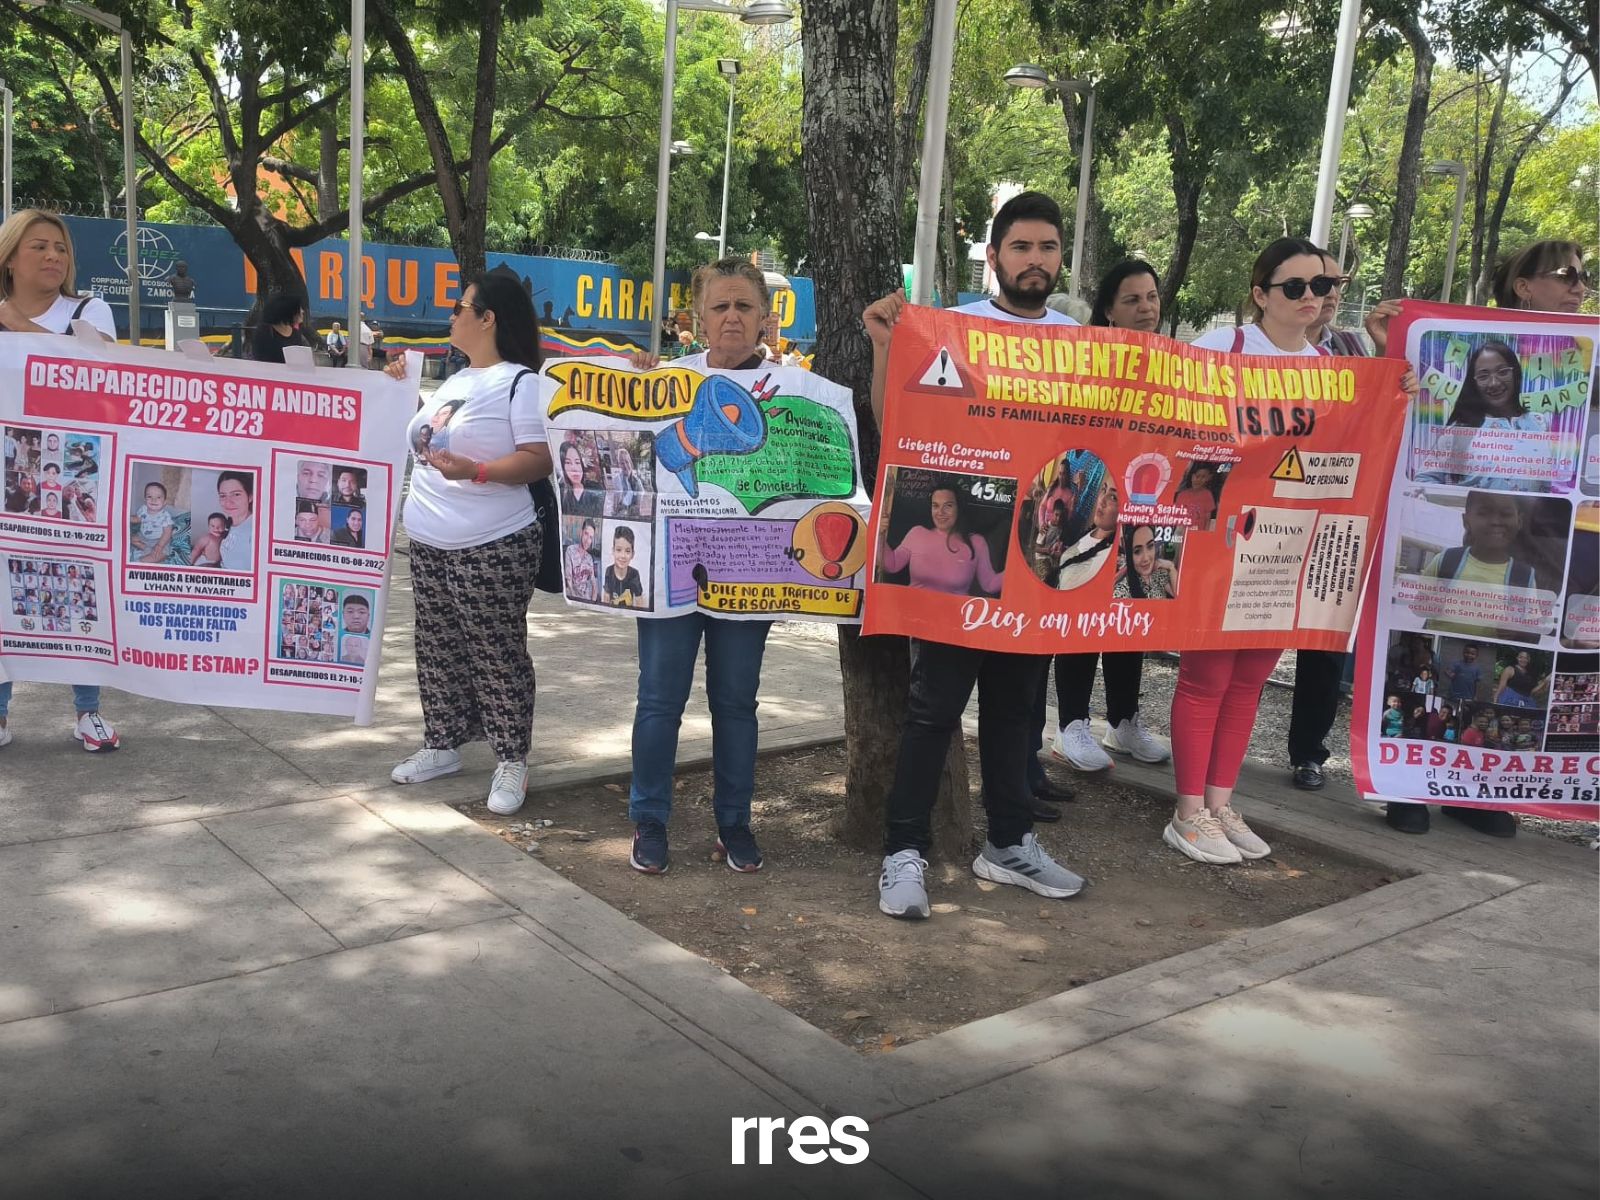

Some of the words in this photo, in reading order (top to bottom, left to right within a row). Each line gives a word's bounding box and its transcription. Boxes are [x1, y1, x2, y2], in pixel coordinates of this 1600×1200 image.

[91, 284, 133, 296] EZEQUIE
[967, 329, 1143, 380] PRESIDENTE
[1146, 348, 1237, 399] NICOLÁS
[1241, 367, 1355, 402] MADURO
[30, 362, 217, 405] DESAPARECIDOS
[222, 381, 267, 410] SAN
[272, 388, 357, 421] ANDRES
[570, 367, 692, 412] ATENCIÓN
[986, 374, 1120, 412] NECESITAMOS
[1119, 387, 1147, 415] DE
[1148, 392, 1174, 420] SU
[1176, 398, 1228, 427] AYUDA
[128, 399, 187, 428] 2022
[205, 408, 264, 436] 2023
[968, 404, 996, 418] MIS
[1001, 407, 1087, 426] FAMILIARES
[1128, 420, 1236, 443] DESAPARECIDOS
[898, 438, 947, 454] Lisbeth
[952, 443, 1011, 460] Coromoto
[921, 453, 984, 470] Gutierrez
[1308, 457, 1320, 467] NO
[1491, 454, 1500, 462] la
[1502, 455, 1533, 463] lancha
[1535, 456, 1545, 465] el
[1546, 457, 1558, 465] 21
[1560, 457, 1572, 465] de
[1473, 464, 1492, 473] San
[1305, 474, 1317, 485] DE
[1317, 475, 1349, 485] PERSONAS
[971, 481, 996, 501] 45
[660, 498, 721, 506] NECESITAMOS
[1157, 504, 1188, 515] Beatriz
[54, 529, 62, 538] EL
[63, 530, 106, 542] 12-10-2022
[1154, 526, 1172, 541] 28
[274, 548, 332, 563] DESAPARECIDOS
[332, 555, 340, 564] EL
[341, 556, 385, 571] 05-08-2022
[784, 546, 806, 562] 40
[1240, 553, 1303, 564] ENCONTRARLOS
[128, 570, 176, 582] AYUDANOS
[177, 574, 184, 582] A
[185, 575, 252, 588] ENCONTRARLOS
[144, 583, 183, 592] LYHANN
[194, 586, 236, 596] NAYARIT
[742, 586, 759, 598] NO
[762, 587, 777, 598] AL
[782, 586, 830, 600] TRAFICO
[836, 592, 850, 603] DE
[1440, 586, 1468, 595] Daniel
[154, 602, 248, 619] DESAPARECIDOS
[718, 597, 802, 610] PERSONAS
[1474, 600, 1482, 608] la
[1484, 601, 1514, 612] lancha
[960, 596, 1031, 637] Dios
[1039, 611, 1072, 638] con
[1077, 601, 1154, 637] nosotros
[1458, 608, 1475, 617] San
[140, 614, 163, 628] NOS
[166, 616, 204, 629] HACEN
[206, 618, 237, 631] FALTA
[164, 629, 172, 640] A
[175, 629, 213, 643] TODOS
[3, 639, 64, 651] DESAPARECIDOS
[65, 643, 73, 651] EL
[75, 644, 112, 656] 17-12-2022
[122, 647, 189, 671] ¿DONDE
[192, 654, 260, 675] ESTAN?
[270, 667, 329, 680] DESAPARECIDOS
[330, 673, 337, 681] EL
[1426, 768, 1436, 779] el
[1447, 770, 1461, 781] 21
[1472, 772, 1489, 783] de
[1499, 774, 1553, 784] octubre
[1564, 776, 1581, 785] de
[1427, 781, 1469, 798] San
[1477, 783, 1563, 800] Andrés
